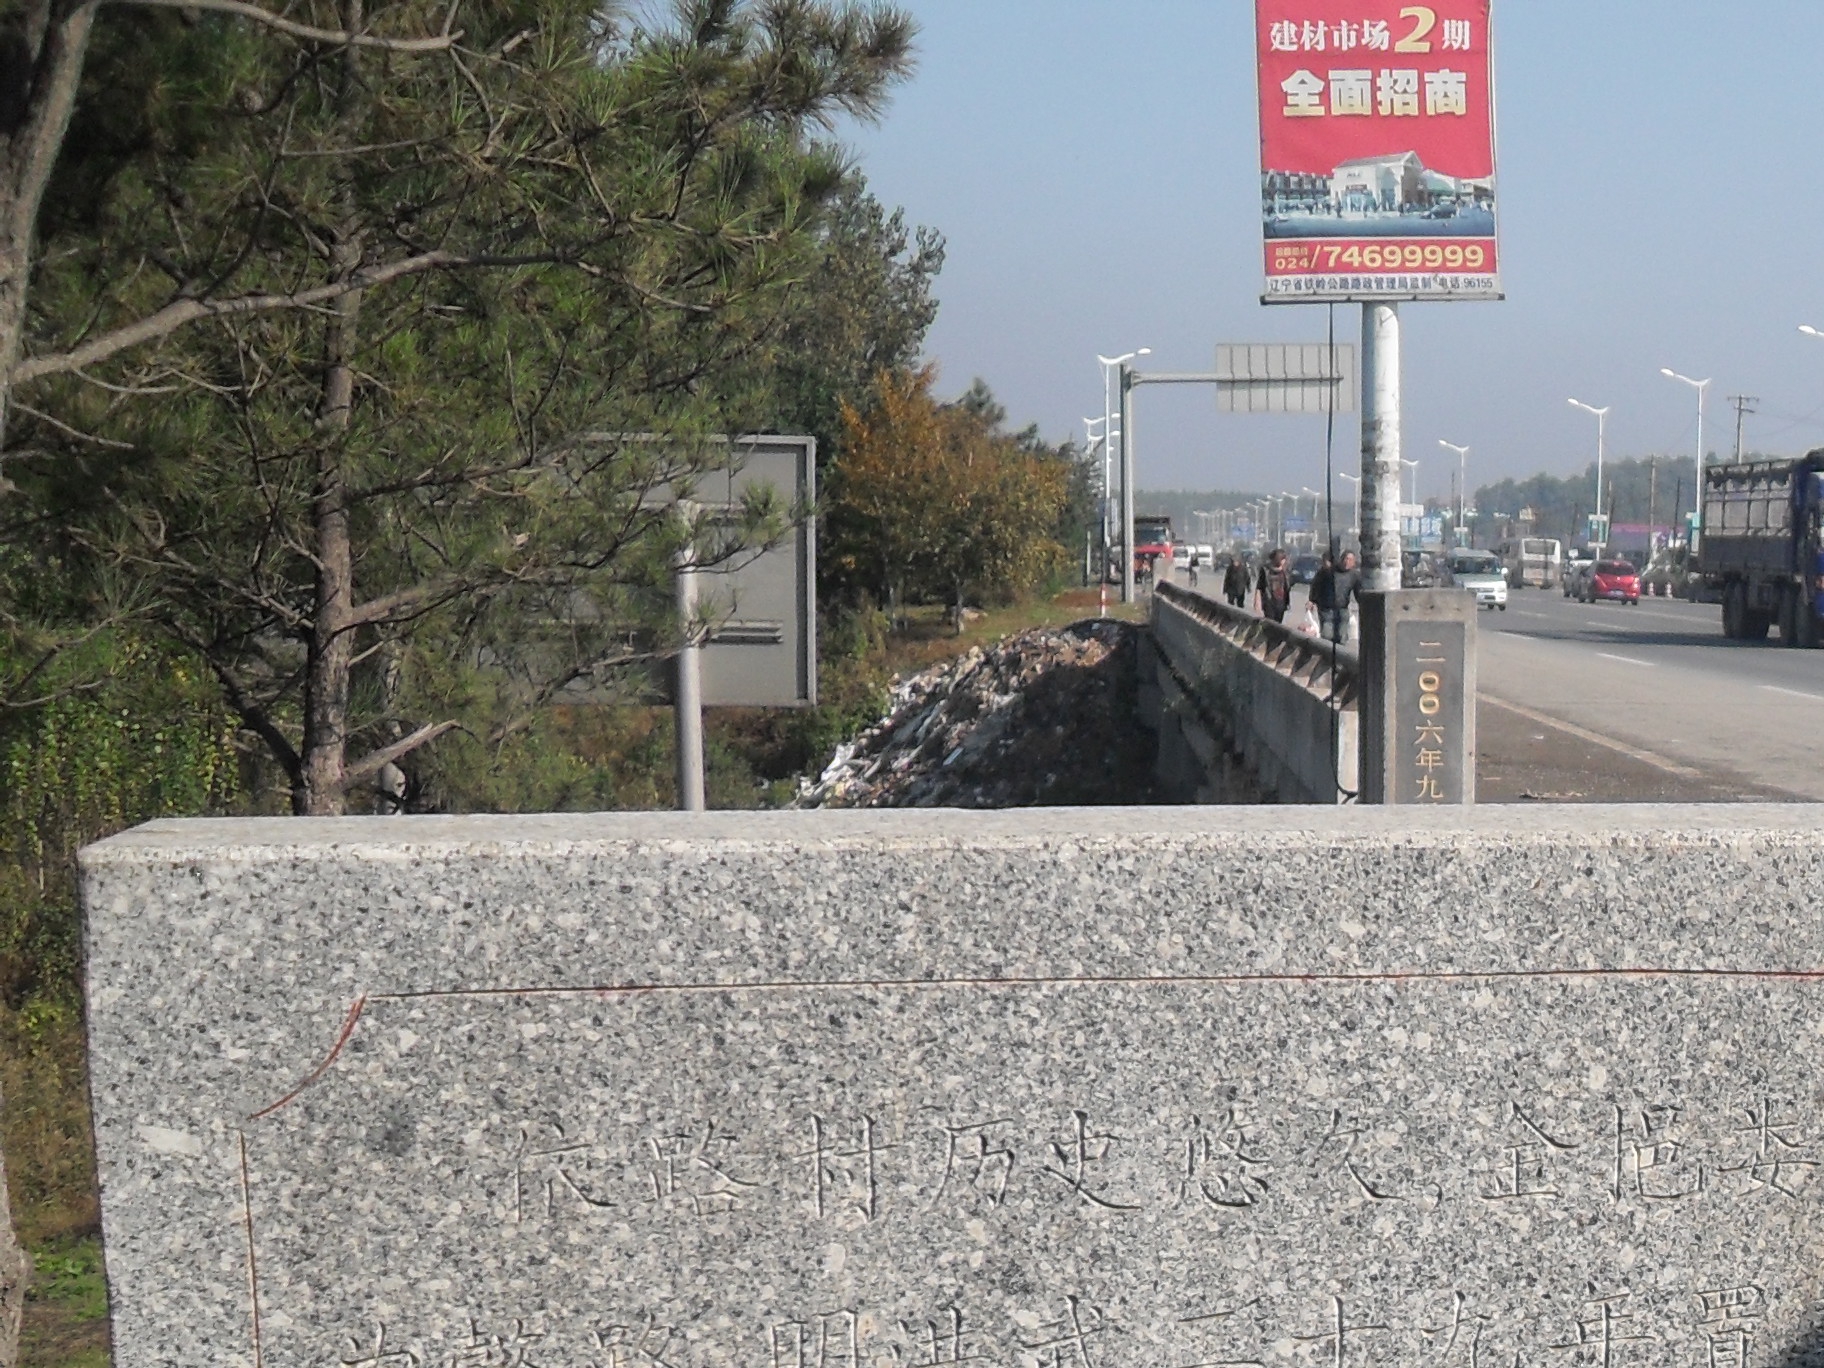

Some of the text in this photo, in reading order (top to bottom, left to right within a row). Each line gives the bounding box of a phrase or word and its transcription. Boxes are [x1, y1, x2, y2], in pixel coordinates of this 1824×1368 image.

[1269, 5, 1472, 53] 建材市场2期
[1280, 68, 1468, 117] 全面招商
